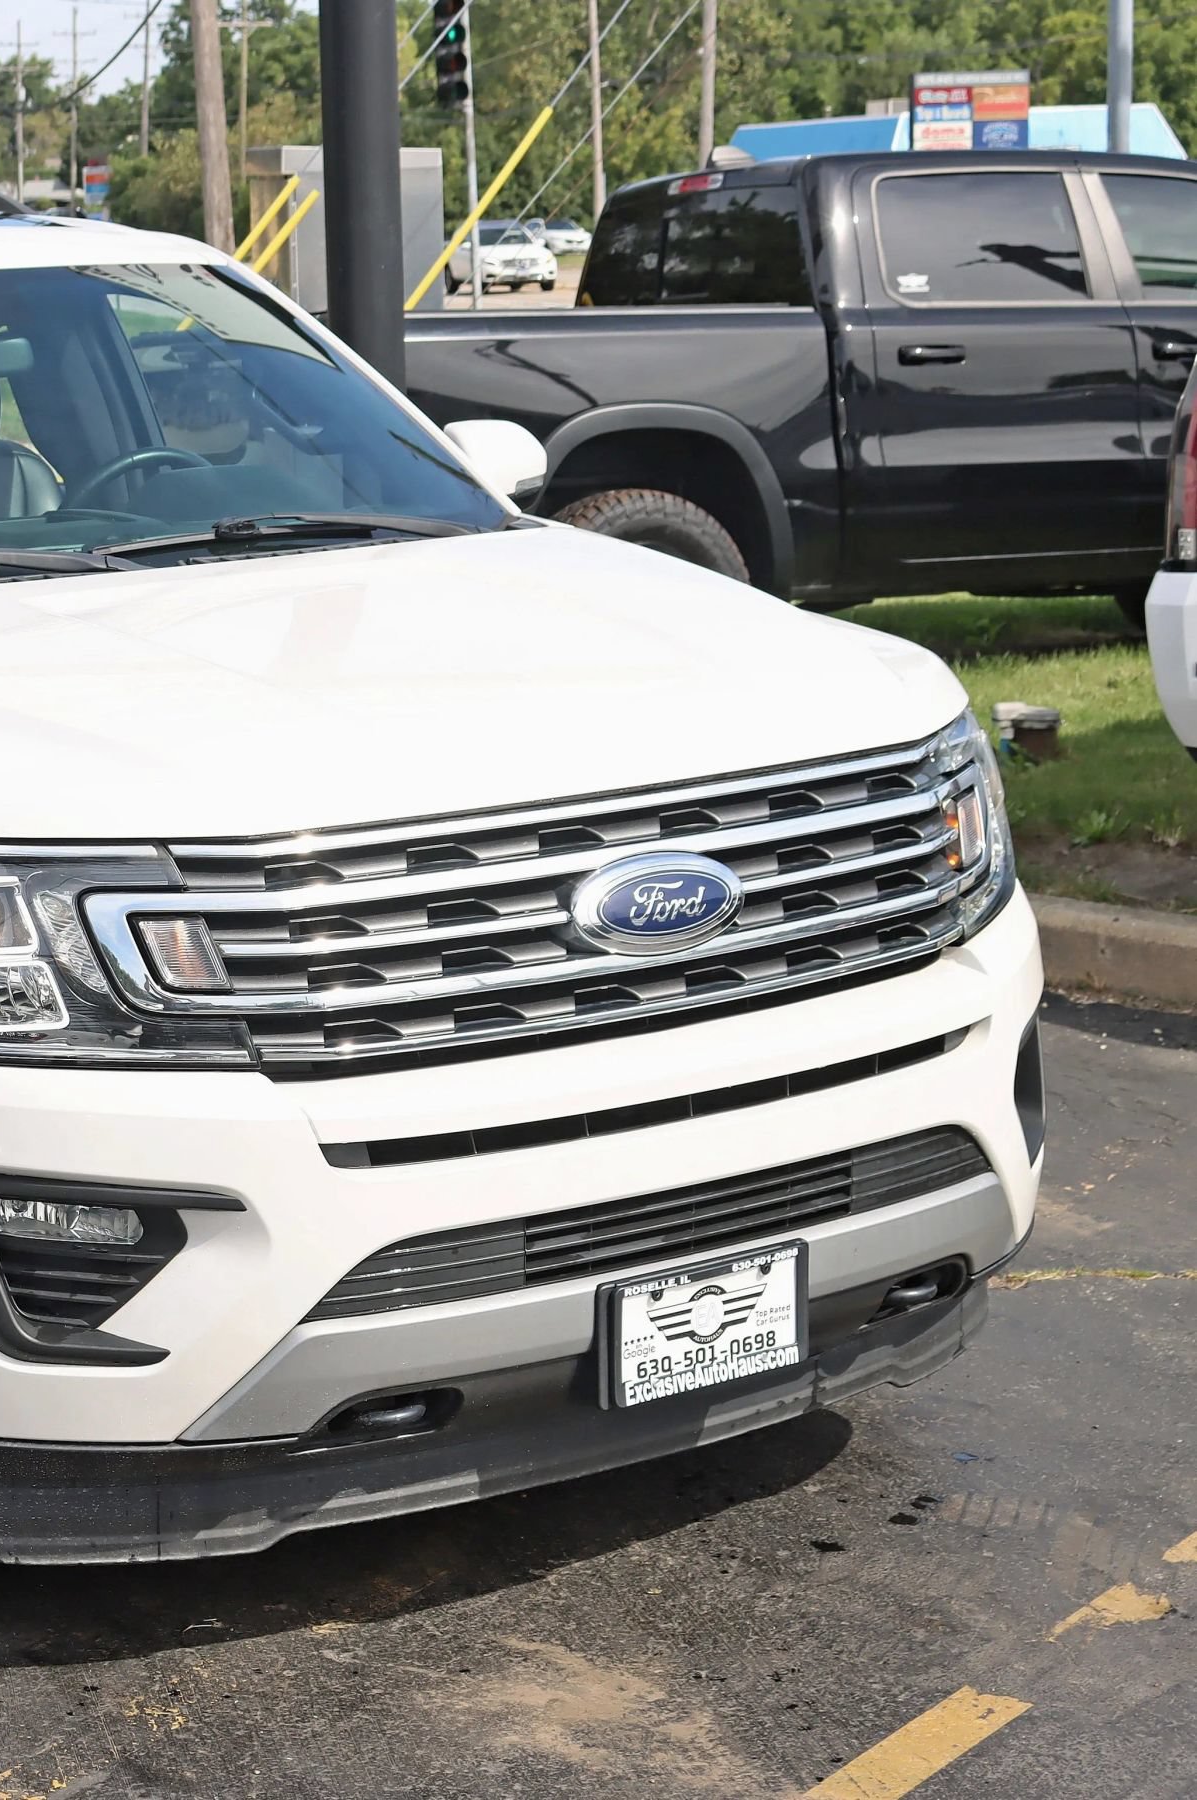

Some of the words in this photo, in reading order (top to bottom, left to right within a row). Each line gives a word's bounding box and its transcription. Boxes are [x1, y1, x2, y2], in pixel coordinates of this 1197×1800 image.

[629, 880, 708, 926] Ford
[732, 1247, 799, 1272] 630-501-0698
[680, 1275, 691, 1285] IL
[755, 1310, 768, 1318] Top
[769, 1304, 791, 1314] Rated
[756, 1318, 768, 1326] Car
[769, 1314, 790, 1323] Gurus
[693, 1328, 723, 1343] AUTOHAUS
[623, 1344, 656, 1360] Google
[636, 1330, 777, 1379] 630-501-0698
